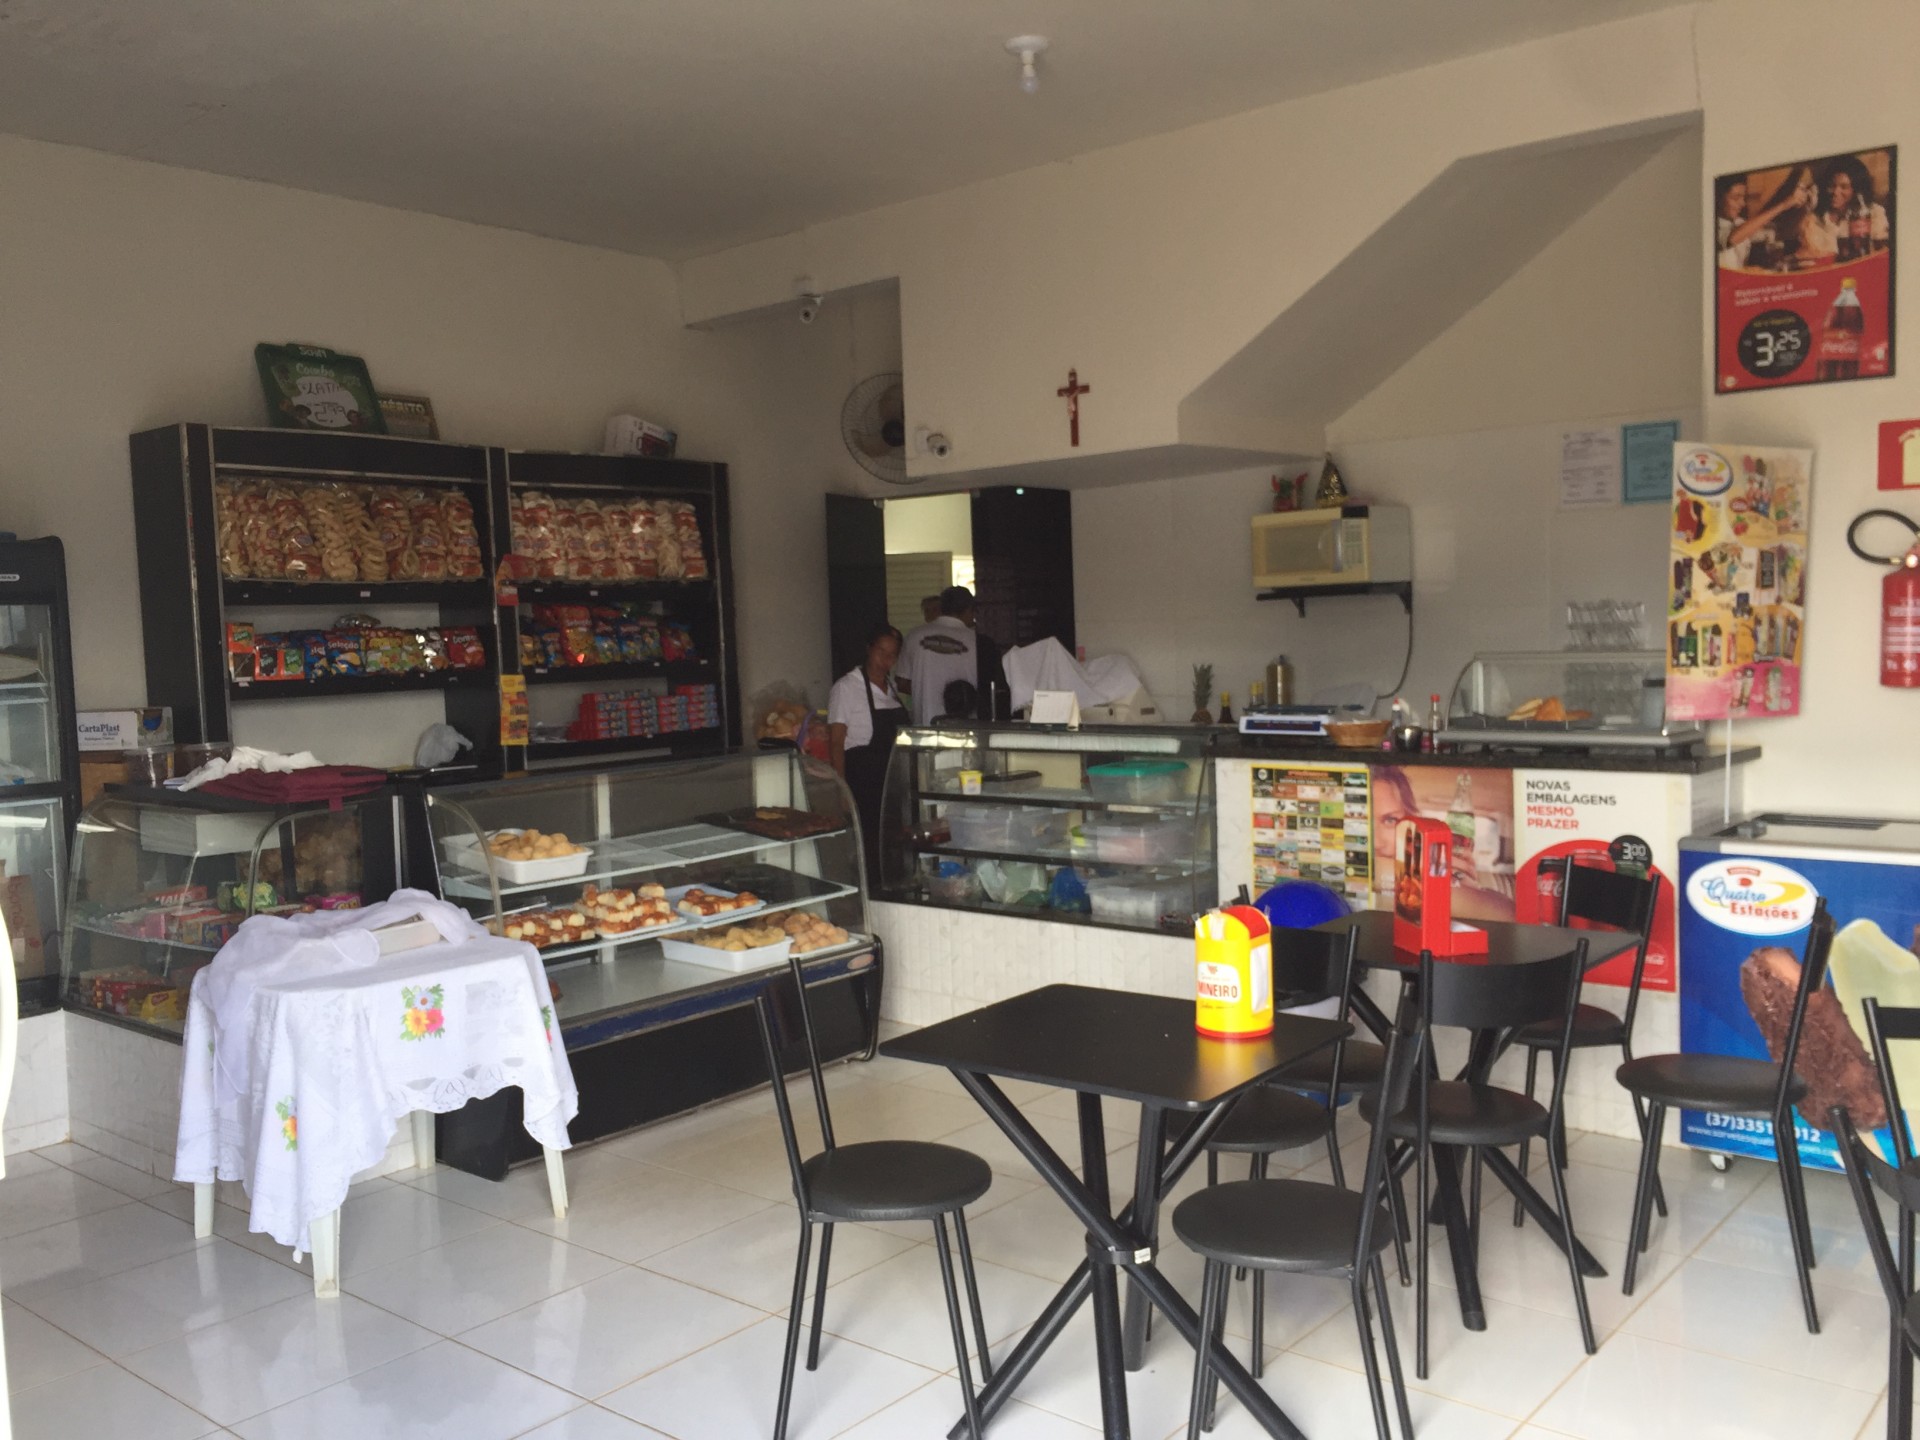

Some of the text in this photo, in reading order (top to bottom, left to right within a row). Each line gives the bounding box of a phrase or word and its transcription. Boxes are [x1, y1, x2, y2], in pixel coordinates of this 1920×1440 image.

[295, 362, 335, 378] Combo
[78, 723, 120, 733] CartaPlast
[1526, 780, 1571, 791] NOVAS
[1526, 792, 1617, 806] EMBALAGENS
[1527, 806, 1574, 817] MESMO
[1527, 818, 1579, 829] PRAZER
[1700, 877, 1767, 908] Quatro
[1730, 902, 1799, 920] Estações
